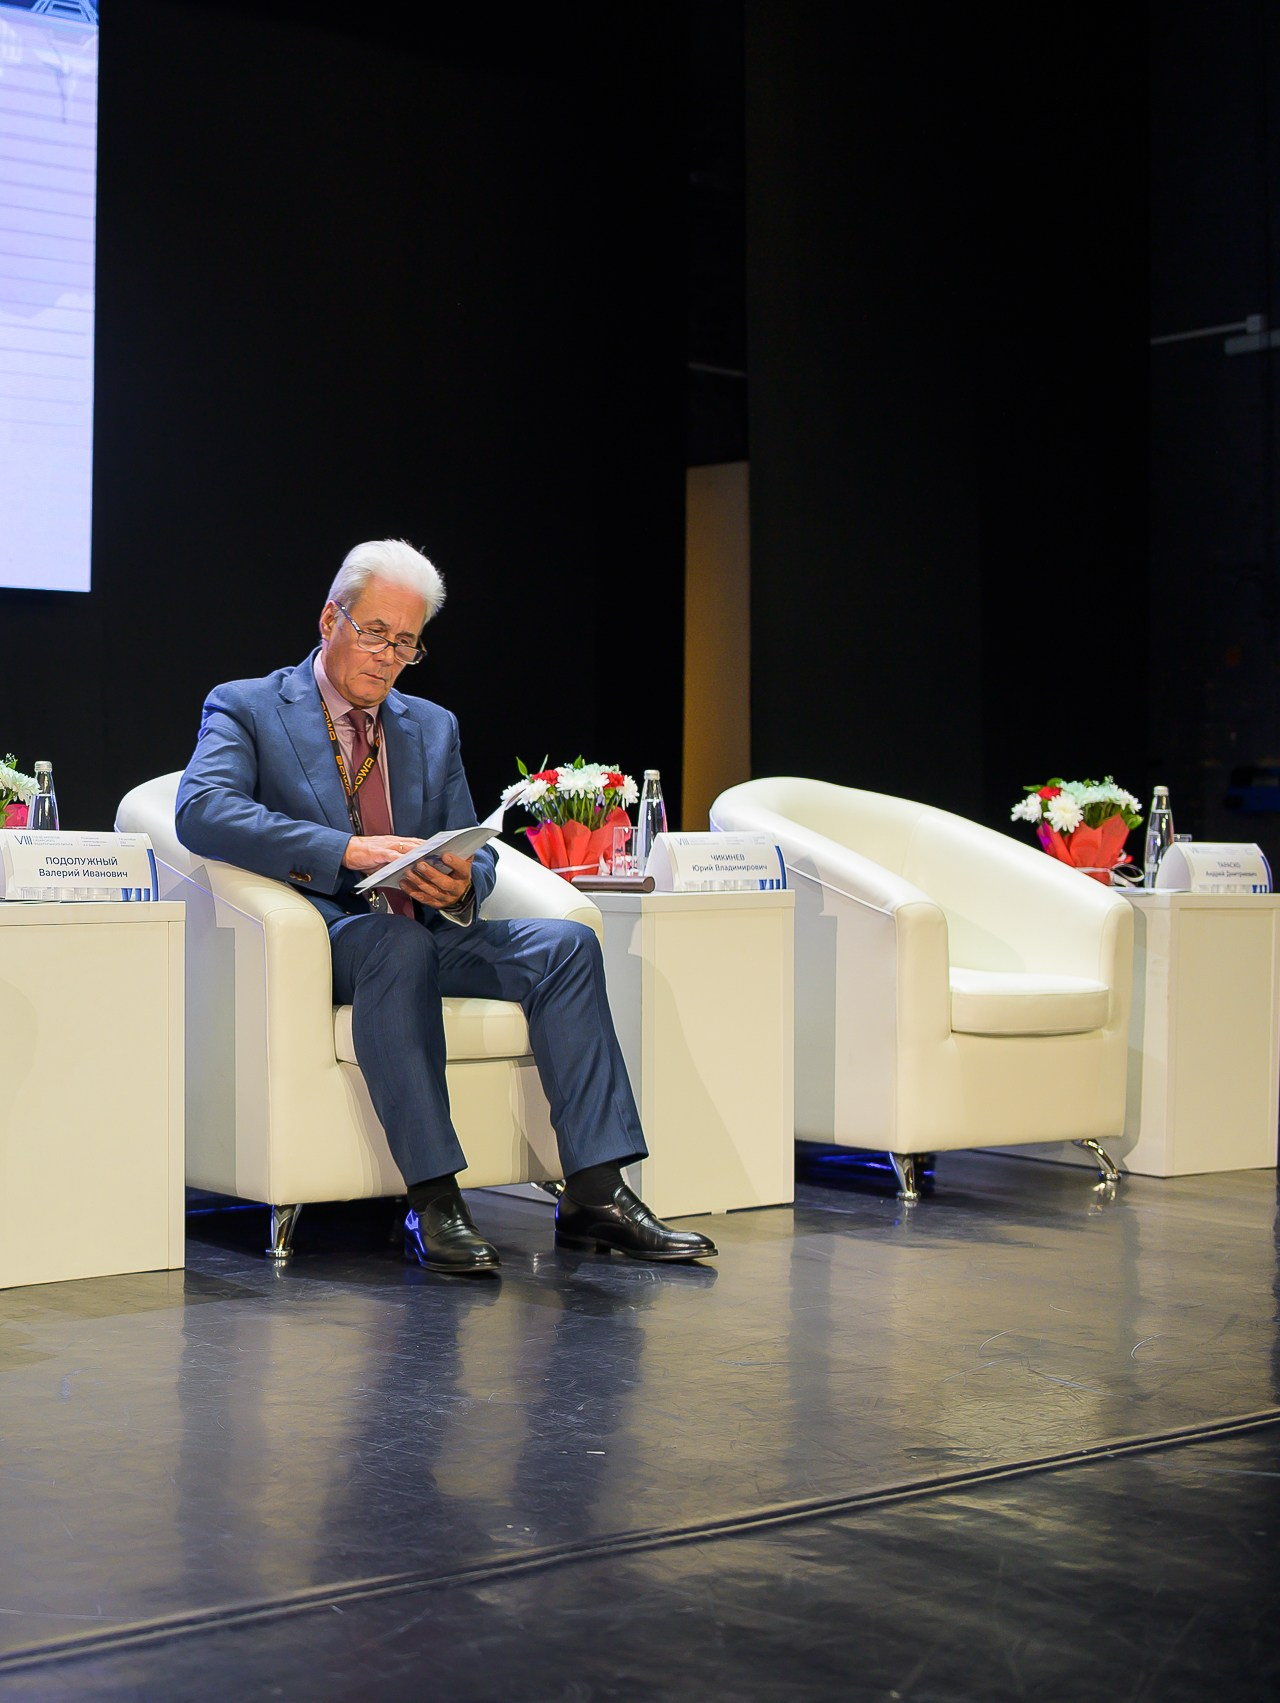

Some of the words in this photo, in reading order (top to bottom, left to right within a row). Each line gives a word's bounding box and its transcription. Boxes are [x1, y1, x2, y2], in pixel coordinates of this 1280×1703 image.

[14, 835, 33, 846] VIII
[45, 856, 118, 867] ПОДОЛУЖНЫЙ
[38, 868, 80, 879] Валерий
[82, 868, 128, 879] Иванович
[692, 864, 714, 873] Юрий
[715, 864, 768, 873] Владимирович
